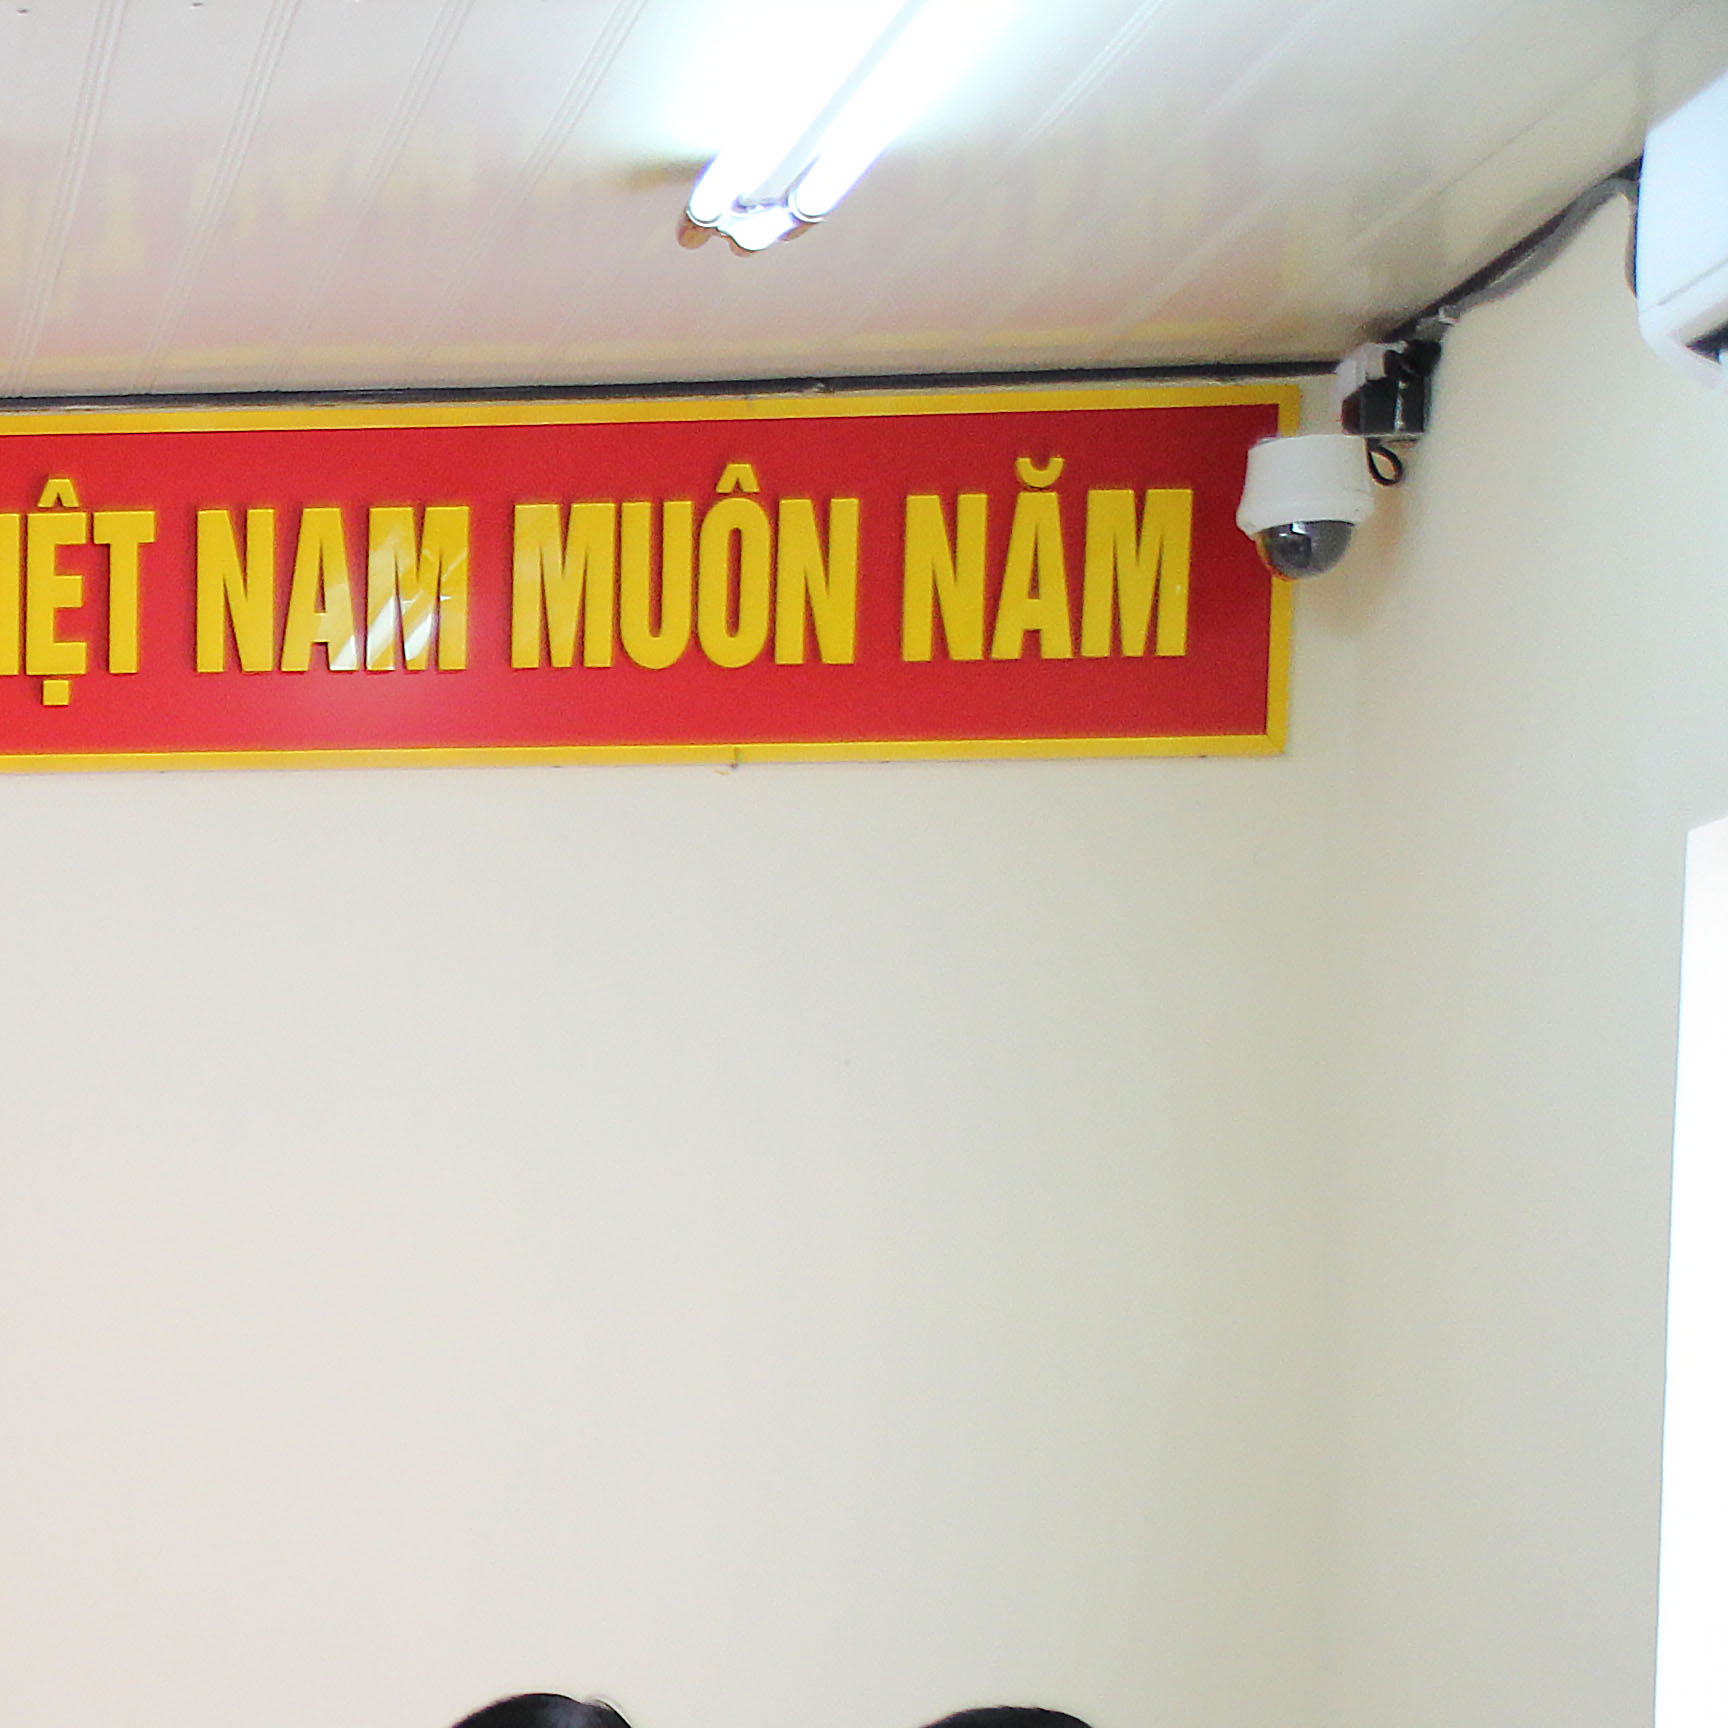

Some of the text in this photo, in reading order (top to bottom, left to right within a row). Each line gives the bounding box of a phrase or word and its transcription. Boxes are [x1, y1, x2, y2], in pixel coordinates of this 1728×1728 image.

[195, 504, 472, 674] NAM
[510, 462, 861, 672] MUÔN
[901, 456, 1194, 663] NĂM
